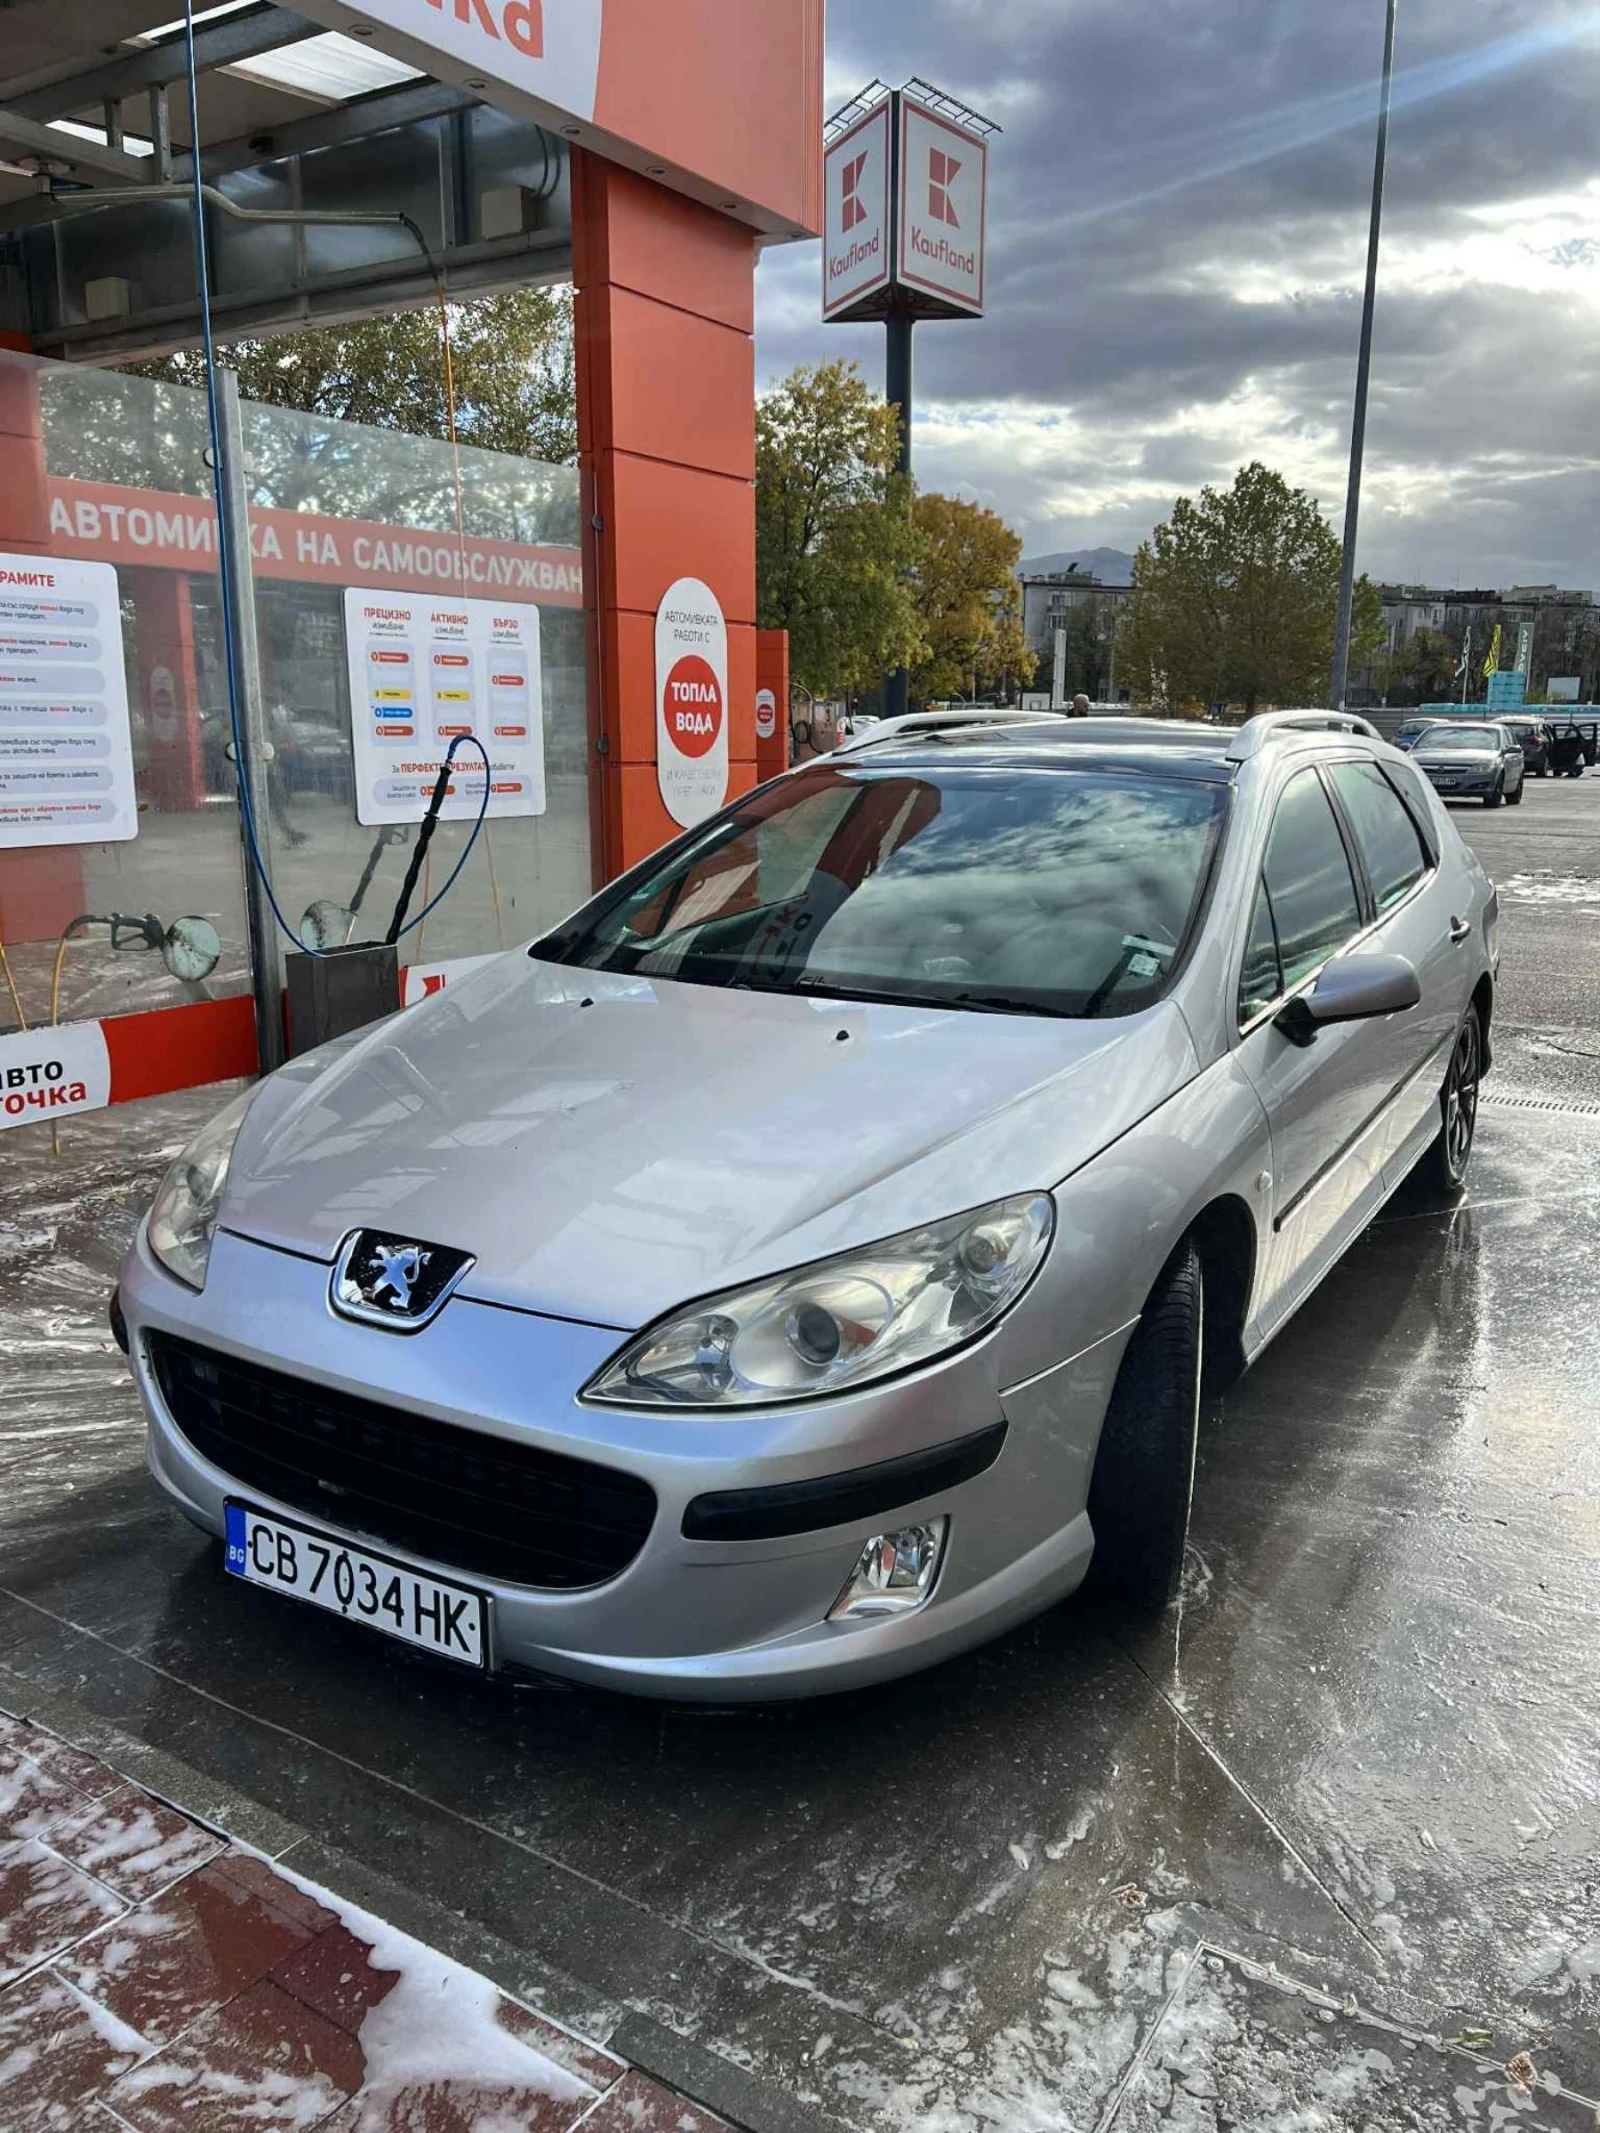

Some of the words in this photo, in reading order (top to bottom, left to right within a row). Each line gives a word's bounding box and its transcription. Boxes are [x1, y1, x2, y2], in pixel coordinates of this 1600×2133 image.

[829, 227, 879, 281] Kaufland
[911, 226, 974, 275] Kaufland
[296, 529, 341, 566] НА
[364, 607, 411, 621] ПРЕЦИЗНО
[430, 611, 468, 625] АКТИВНО
[493, 618, 518, 629] БЪРЗО
[665, 610, 718, 625] АВТОМИВКАТА
[674, 629, 704, 642] РАБОТИ
[671, 682, 717, 702] ТОПЛА
[676, 712, 713, 734] ВОДА
[0, 1061, 63, 1089] вто
[229, 1545, 244, 1563] BG
[252, 1524, 298, 1585] CB
[308, 1543, 404, 1628] 7034
[414, 1583, 471, 1654] HK
